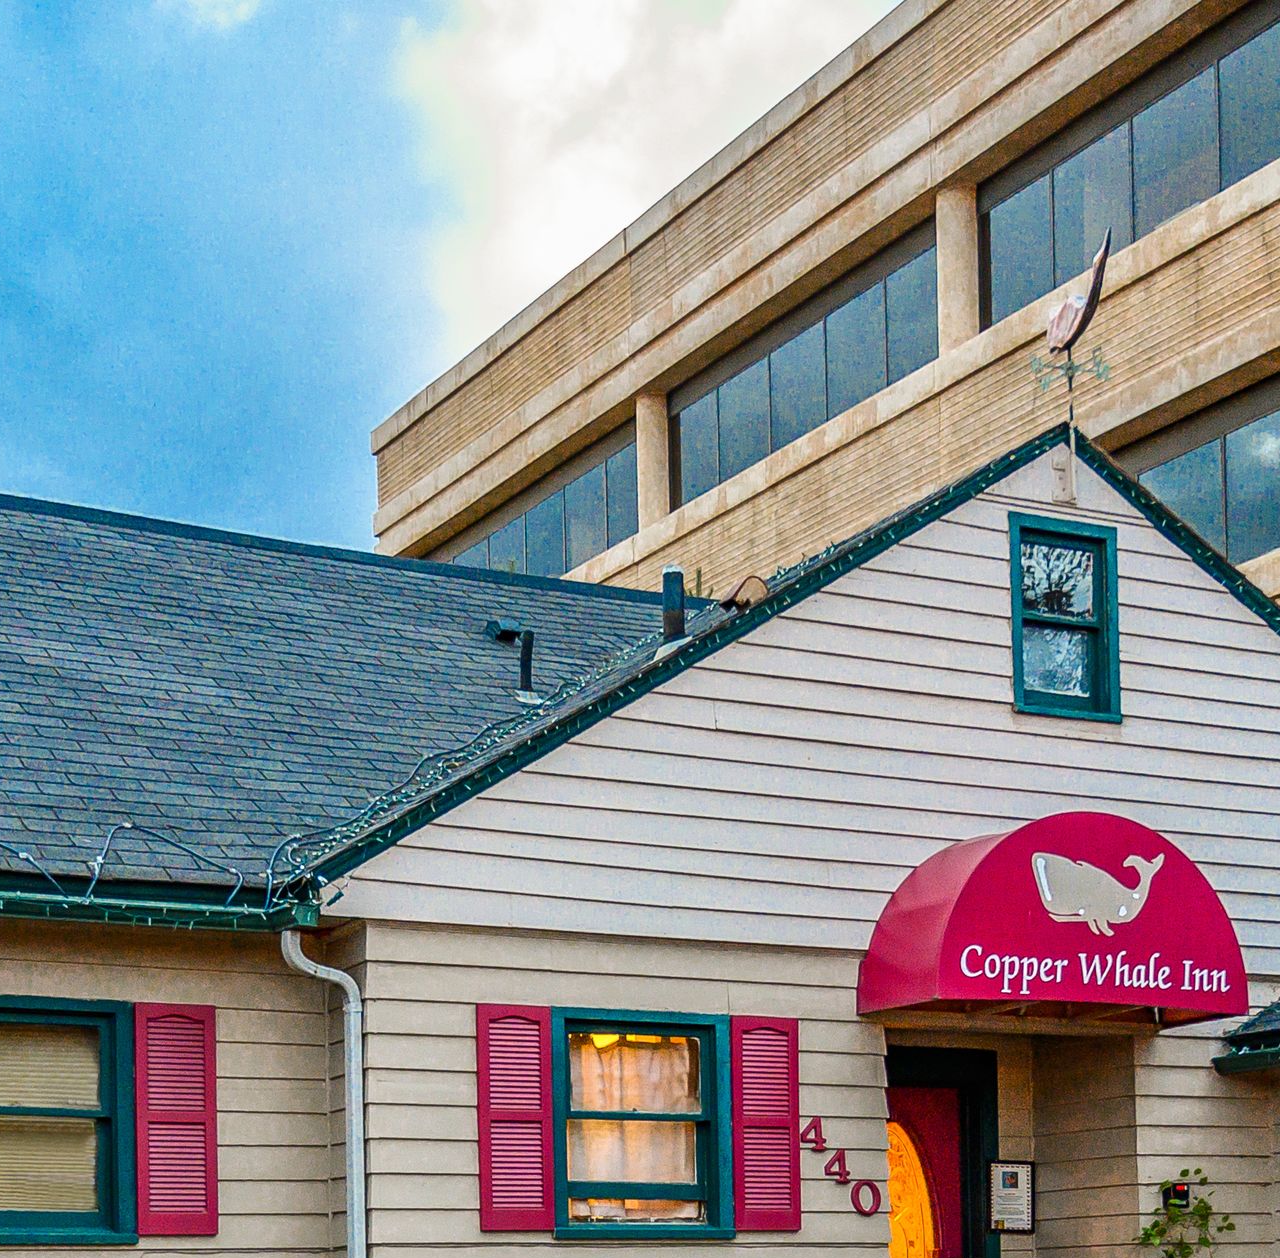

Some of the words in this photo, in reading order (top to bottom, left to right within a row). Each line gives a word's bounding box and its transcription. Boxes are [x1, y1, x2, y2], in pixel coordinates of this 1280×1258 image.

[960, 944, 1068, 995] Copper
[1078, 950, 1172, 990] Whale
[1180, 959, 1231, 993] Inn
